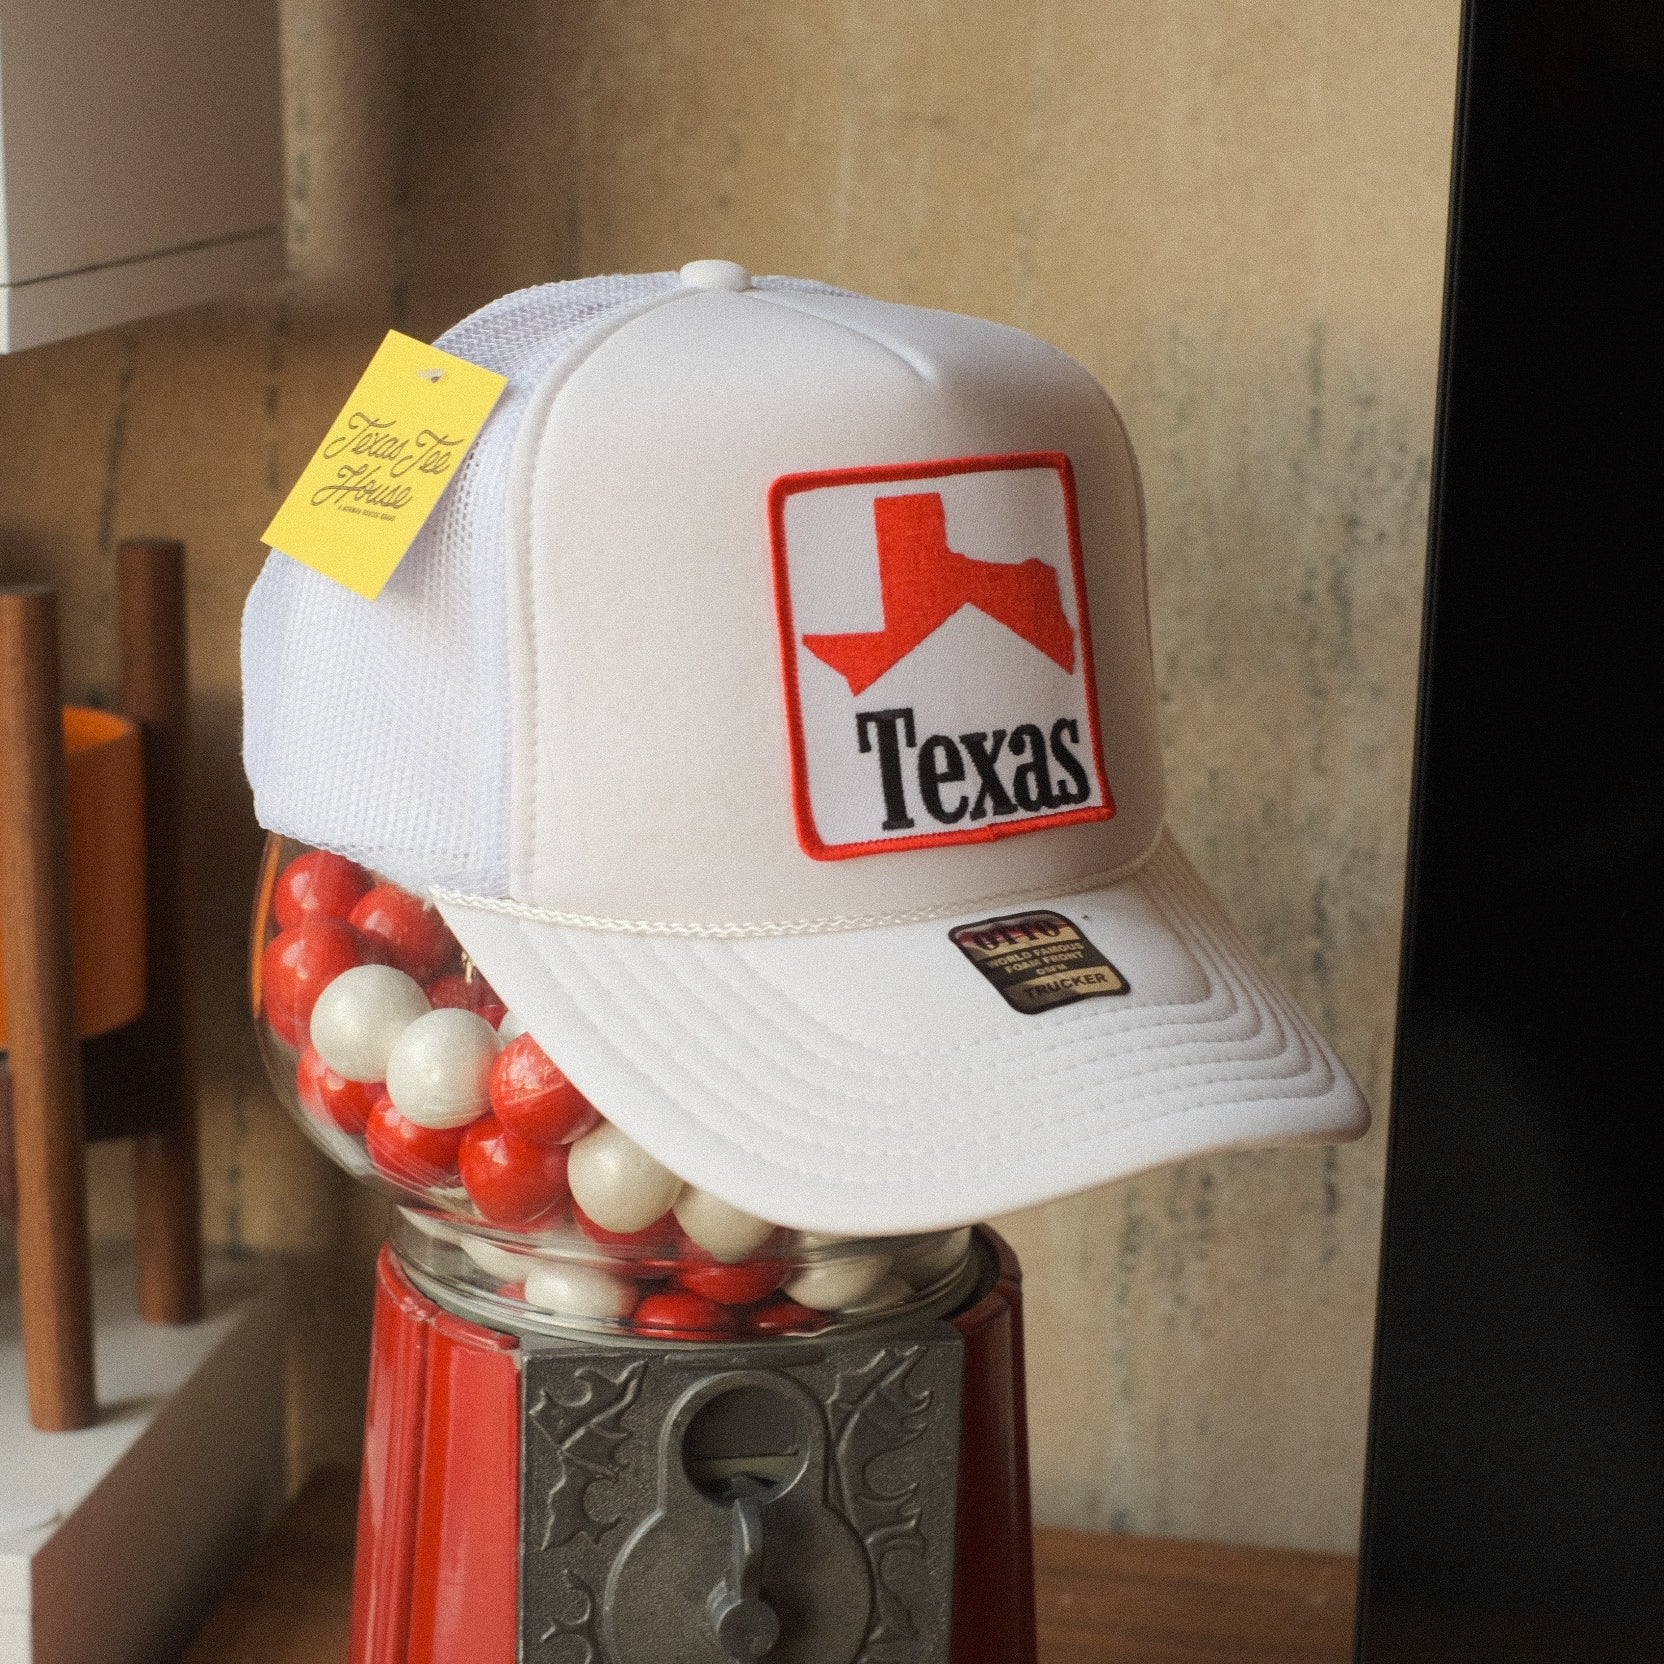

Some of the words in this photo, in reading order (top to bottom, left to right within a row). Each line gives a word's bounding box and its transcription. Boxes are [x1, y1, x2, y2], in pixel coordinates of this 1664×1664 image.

[324, 412, 410, 460] Texas
[390, 429, 465, 477] Tee
[311, 464, 414, 509] House
[856, 707, 1090, 831] Texas
[987, 951, 1032, 968] WORLD
[1035, 942, 1085, 957] FAMOUS
[1004, 960, 1042, 973] FOAM
[1044, 951, 1083, 966] FRONT
[1024, 973, 1108, 998] TRUCKER
